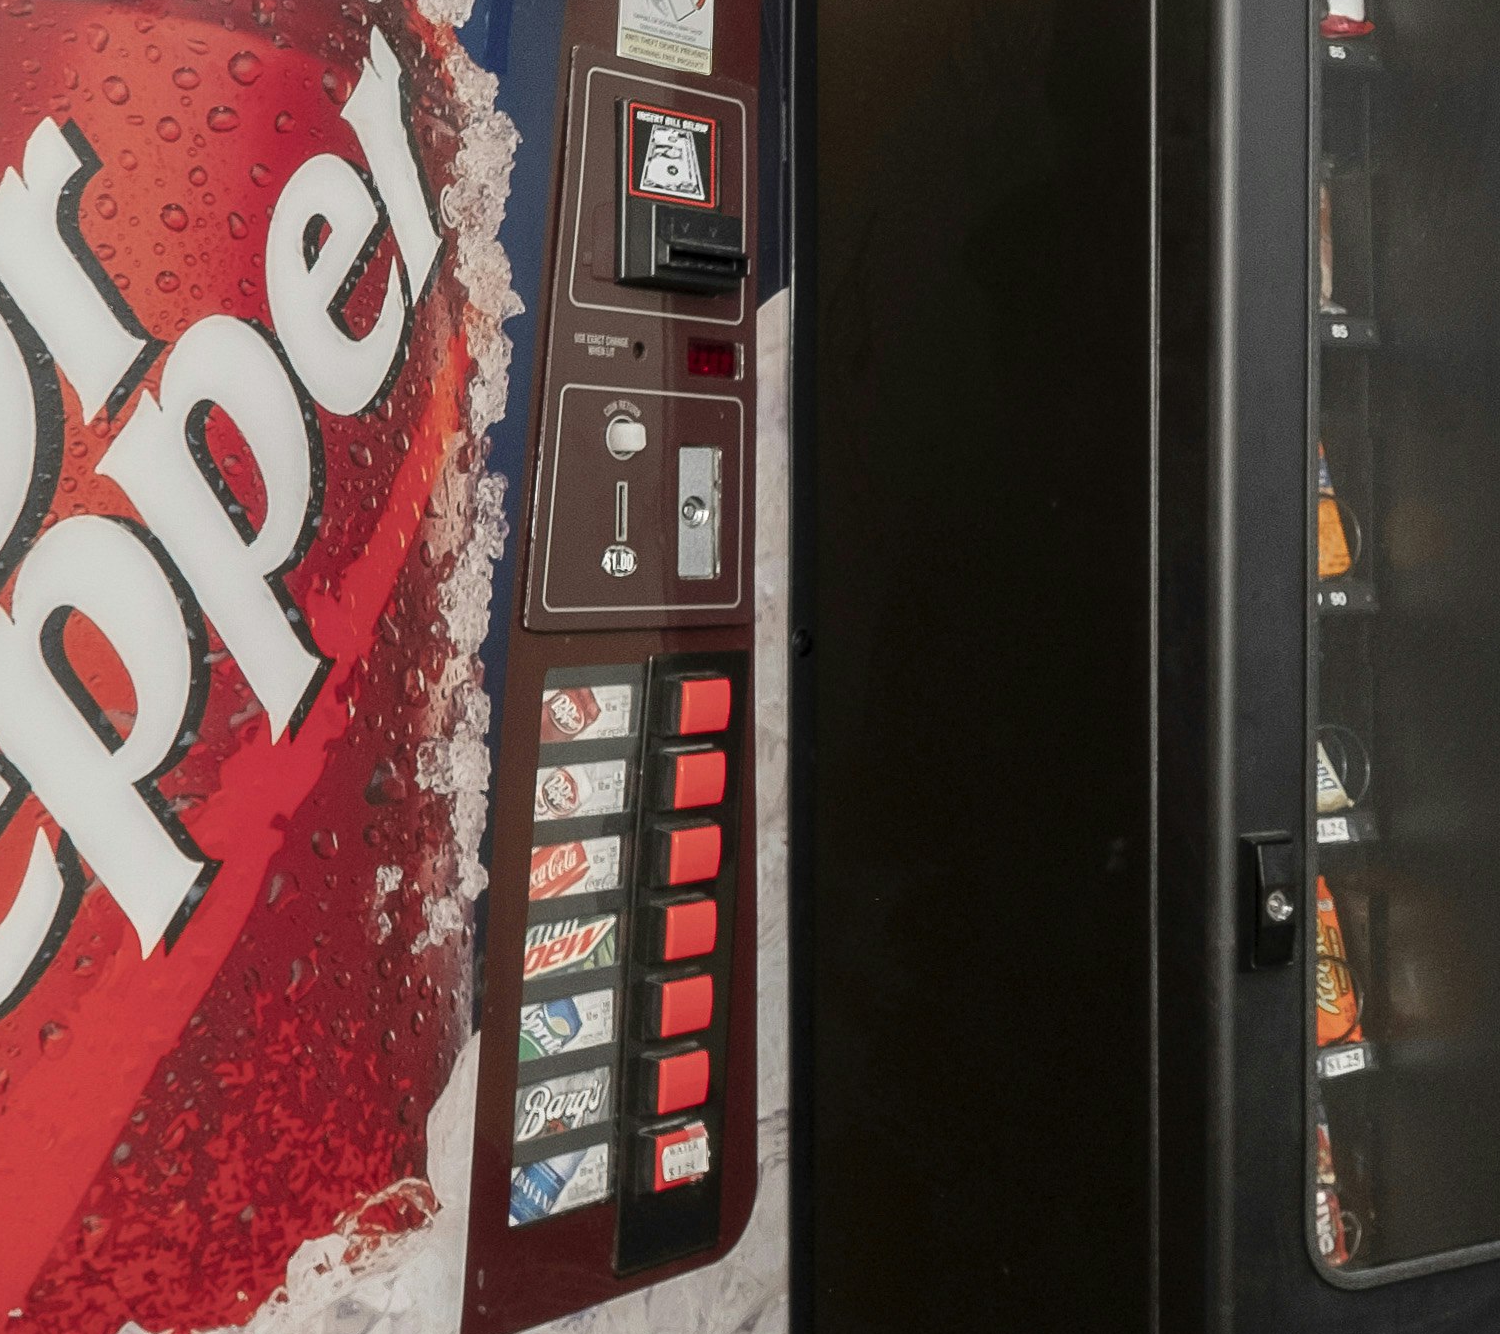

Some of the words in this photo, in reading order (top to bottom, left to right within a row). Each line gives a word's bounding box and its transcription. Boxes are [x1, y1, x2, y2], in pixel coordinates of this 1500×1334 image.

[665, 116, 681, 128] BILL
[682, 120, 709, 133] BELOW
[586, 334, 605, 345] EXACT
[605, 336, 629, 348] CHANGE
[618, 399, 642, 418] RETURN
[1329, 591, 1347, 606] 90
[516, 1080, 602, 1142] Barq's
